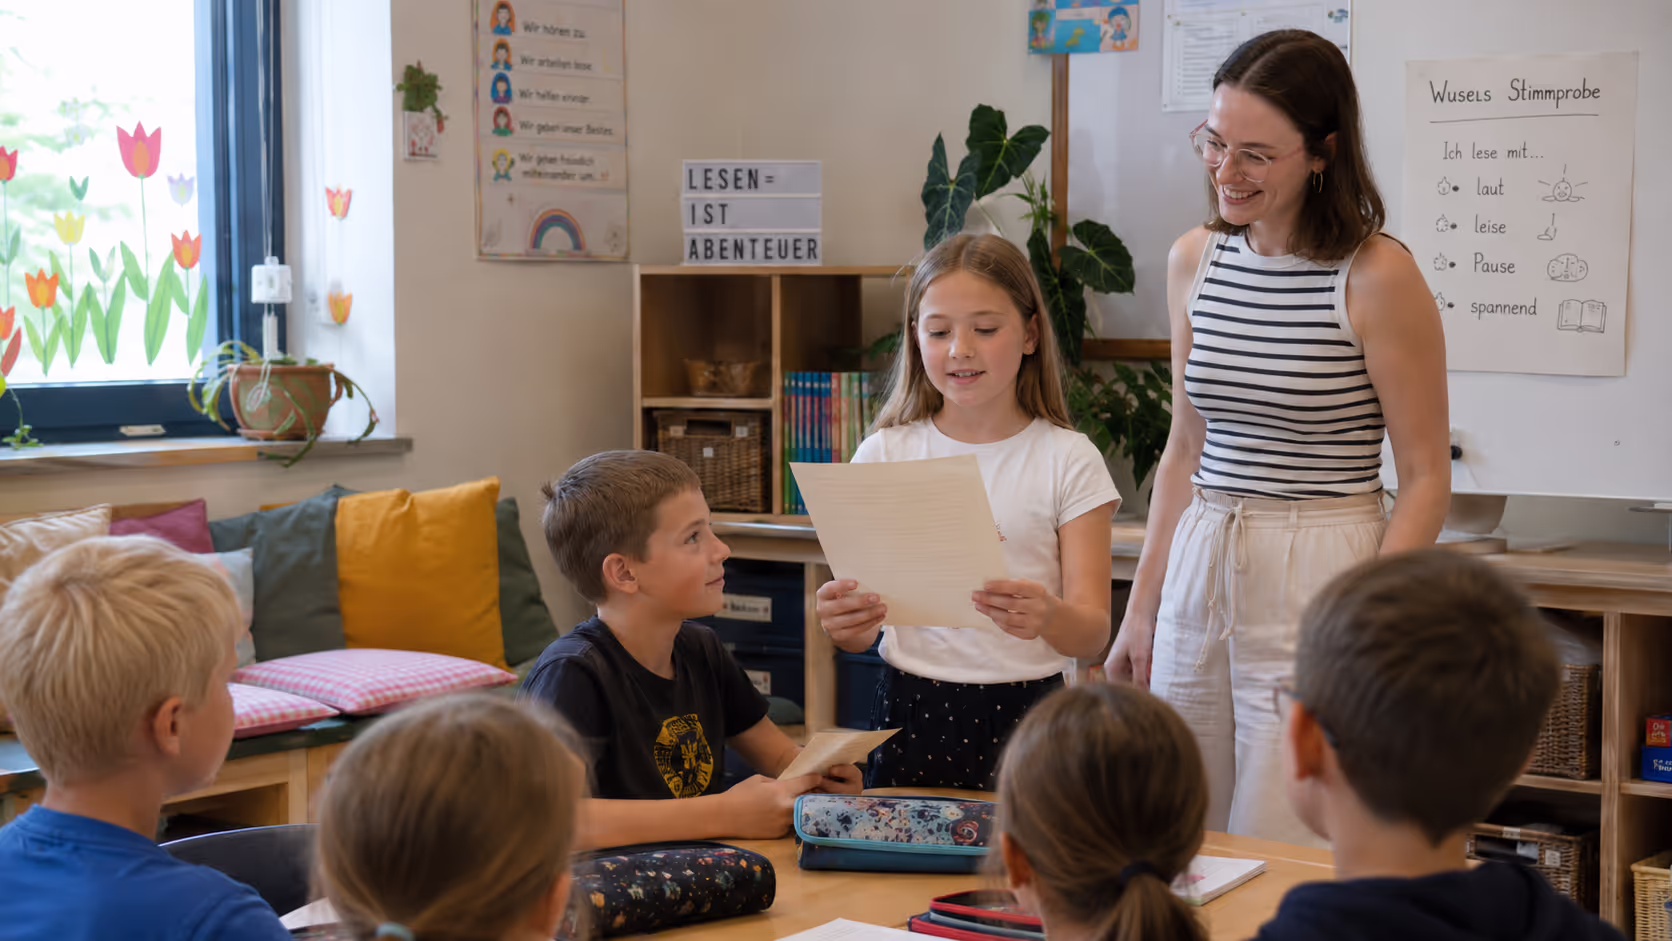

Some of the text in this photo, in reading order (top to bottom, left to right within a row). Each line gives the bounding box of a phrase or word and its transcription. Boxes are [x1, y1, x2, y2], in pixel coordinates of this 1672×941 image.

[523, 21, 541, 33] Wir
[520, 54, 535, 65] Wir
[519, 88, 534, 99] Wir
[1507, 77, 1601, 109] Stimmprobe
[519, 120, 534, 131] Wir
[518, 152, 533, 163] Wir
[1442, 141, 1462, 160] Ich
[1472, 142, 1498, 160] lese
[1477, 176, 1505, 196] laut
[691, 203, 729, 225] IST
[1475, 213, 1507, 235] leise
[688, 238, 818, 260] ABENTEUER
[1473, 252, 1516, 274] Pause
[1470, 297, 1538, 321] spannend
